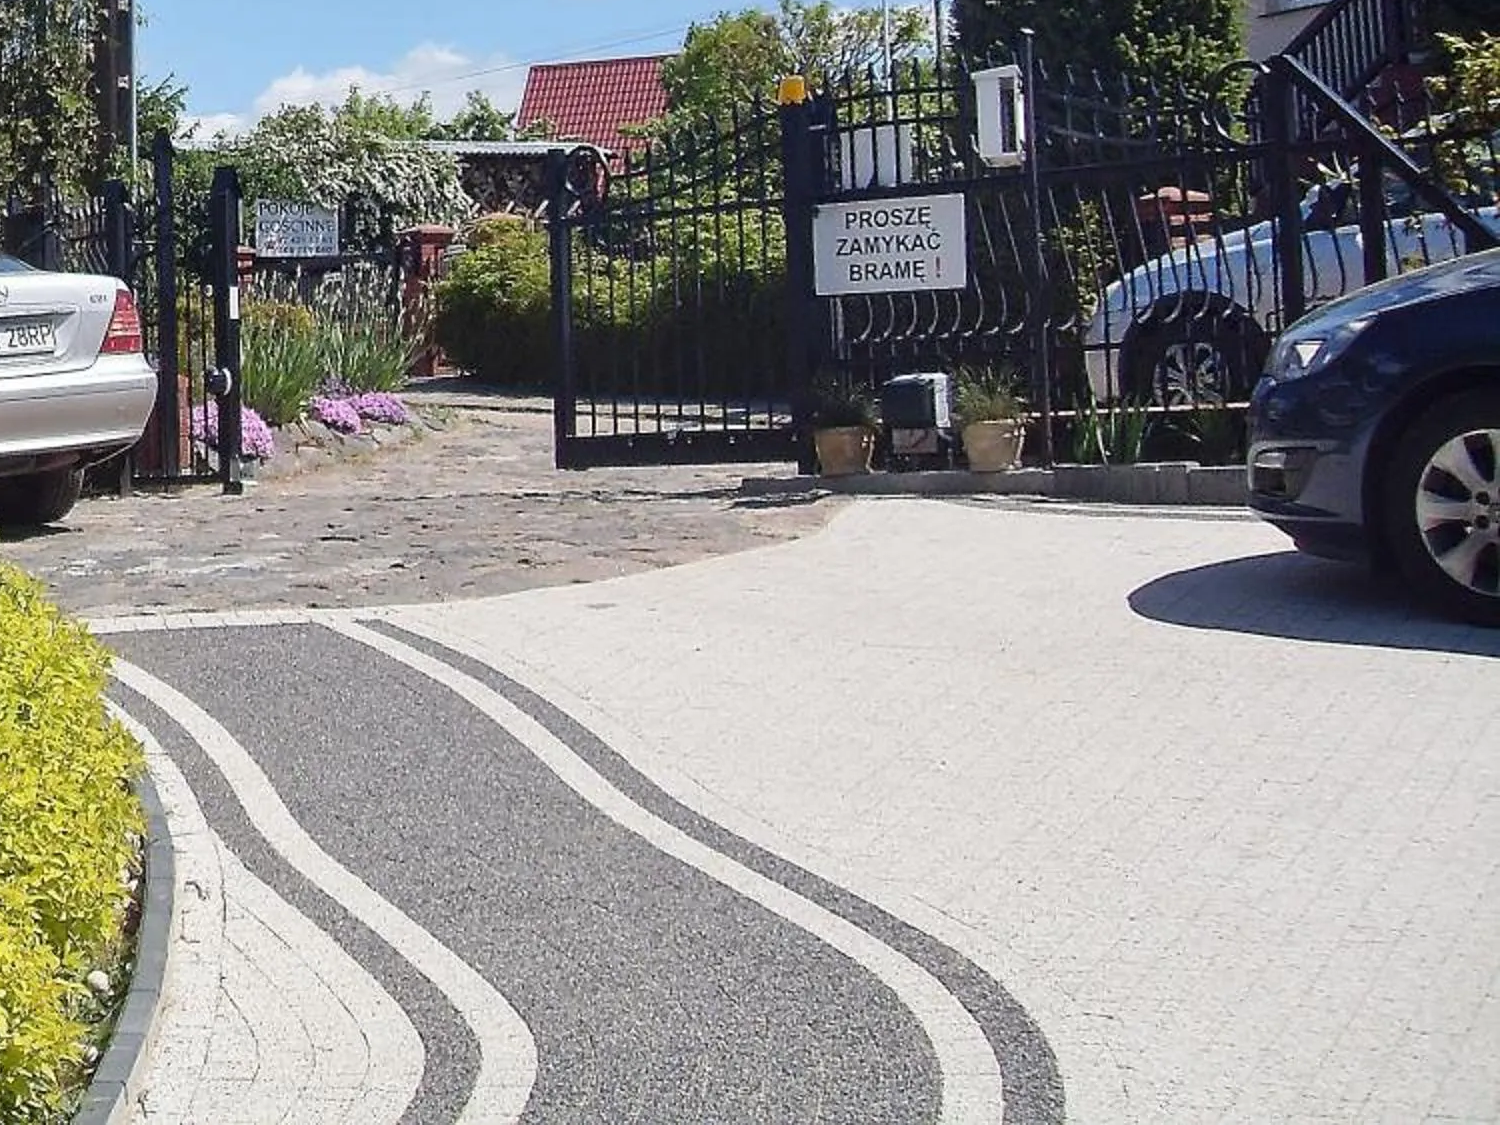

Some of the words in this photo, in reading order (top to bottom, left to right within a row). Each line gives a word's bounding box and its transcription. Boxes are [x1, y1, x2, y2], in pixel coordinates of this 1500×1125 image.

[845, 206, 931, 229] PROSZĘ
[836, 228, 941, 256] ZAMYKAĆ
[850, 260, 925, 283] BRAMĘ
